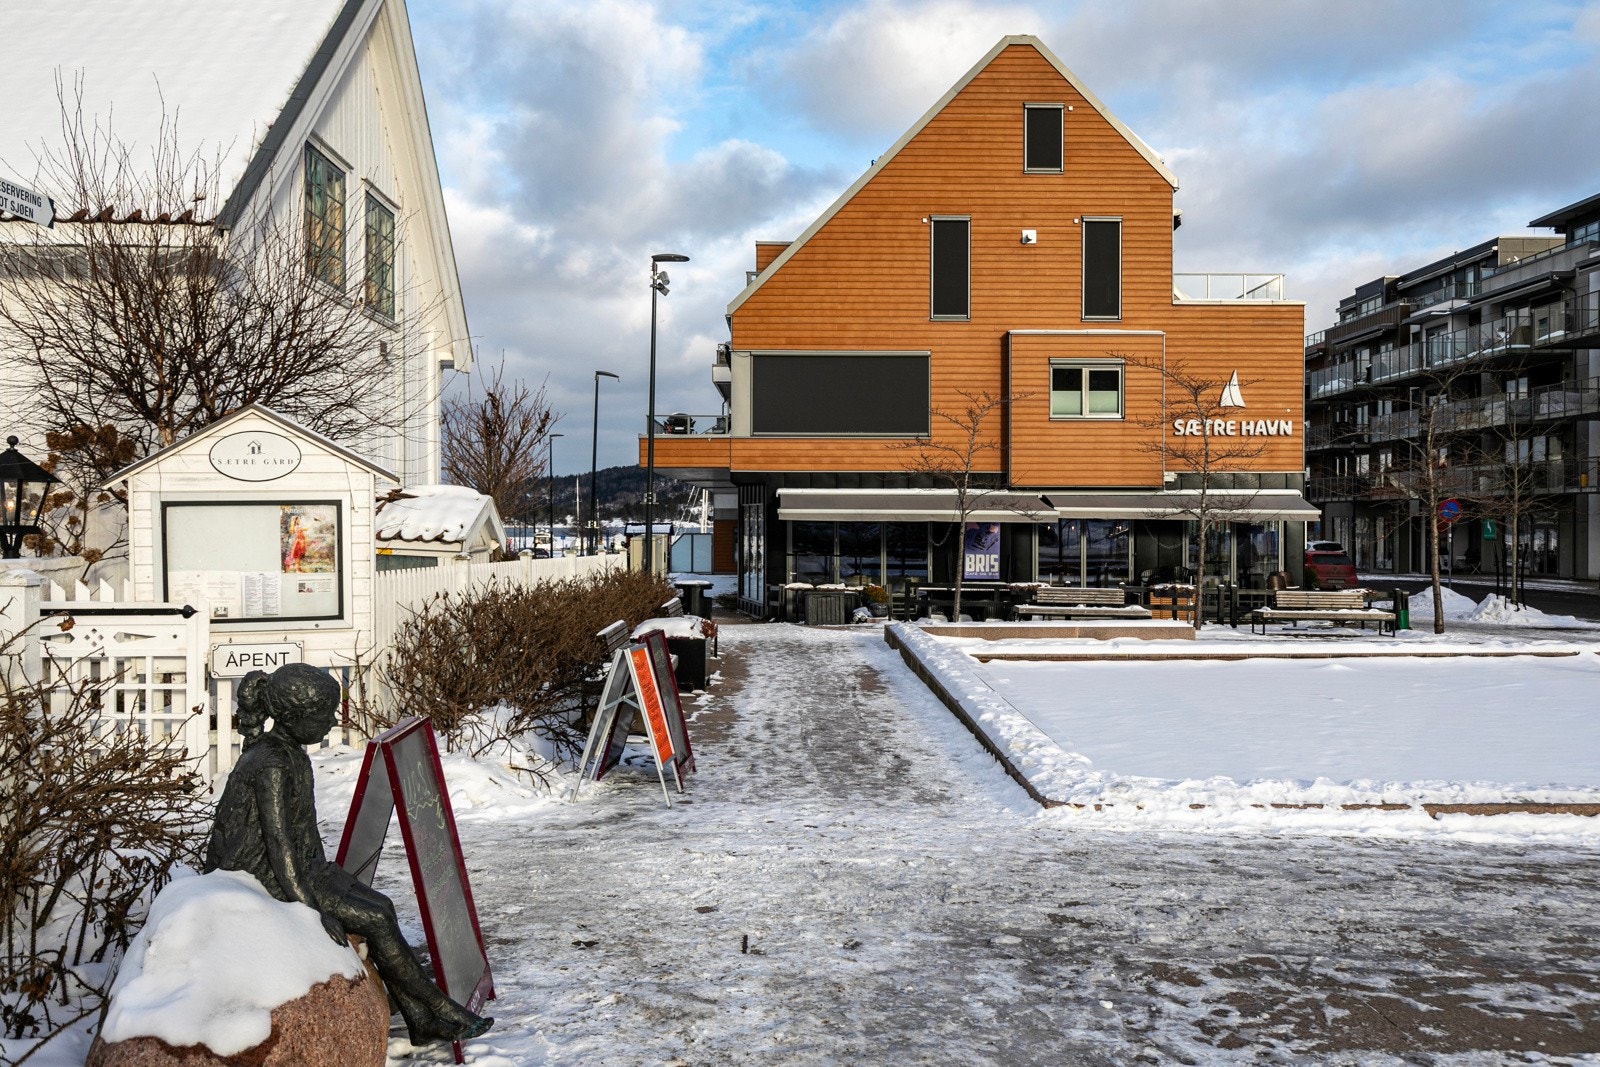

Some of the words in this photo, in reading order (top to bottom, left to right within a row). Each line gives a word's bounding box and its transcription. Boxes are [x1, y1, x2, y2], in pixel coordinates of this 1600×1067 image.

[0, 180, 42, 208] SERVERING
[1174, 419, 1236, 436] SÆTRE
[1241, 420, 1293, 436] HAVN
[965, 554, 999, 572] BRIS
[226, 651, 290, 668] ÅPENT
